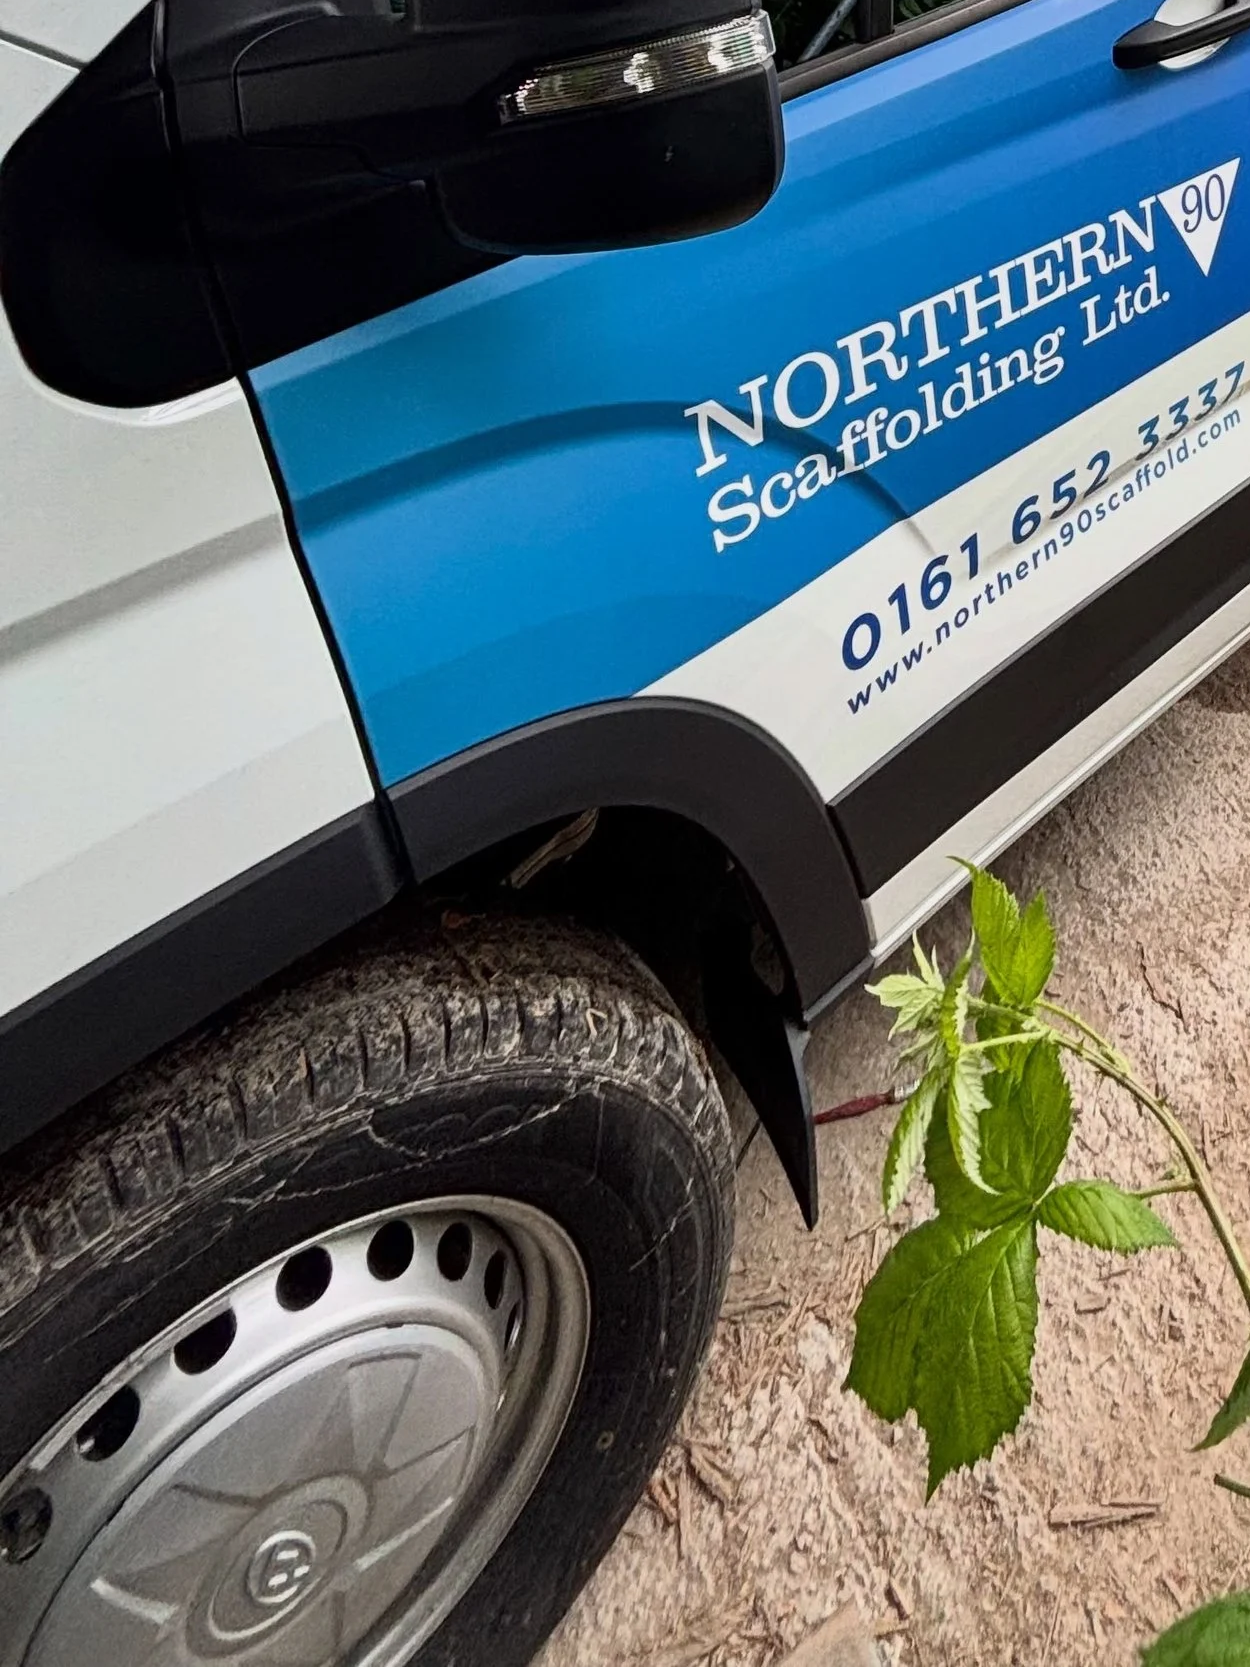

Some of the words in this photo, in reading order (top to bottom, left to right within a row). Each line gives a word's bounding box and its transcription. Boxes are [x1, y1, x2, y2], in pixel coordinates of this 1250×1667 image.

[683, 195, 1158, 477] NORTHERN
[1180, 172, 1226, 233] 90
[706, 325, 1065, 553] Scaffolding
[1080, 266, 1171, 345] Ltd.
[841, 534, 980, 672] 0161
[1011, 450, 1112, 545] 652
[1134, 360, 1245, 462] 3337
[846, 406, 1241, 715] www.northern90scaffold.com
